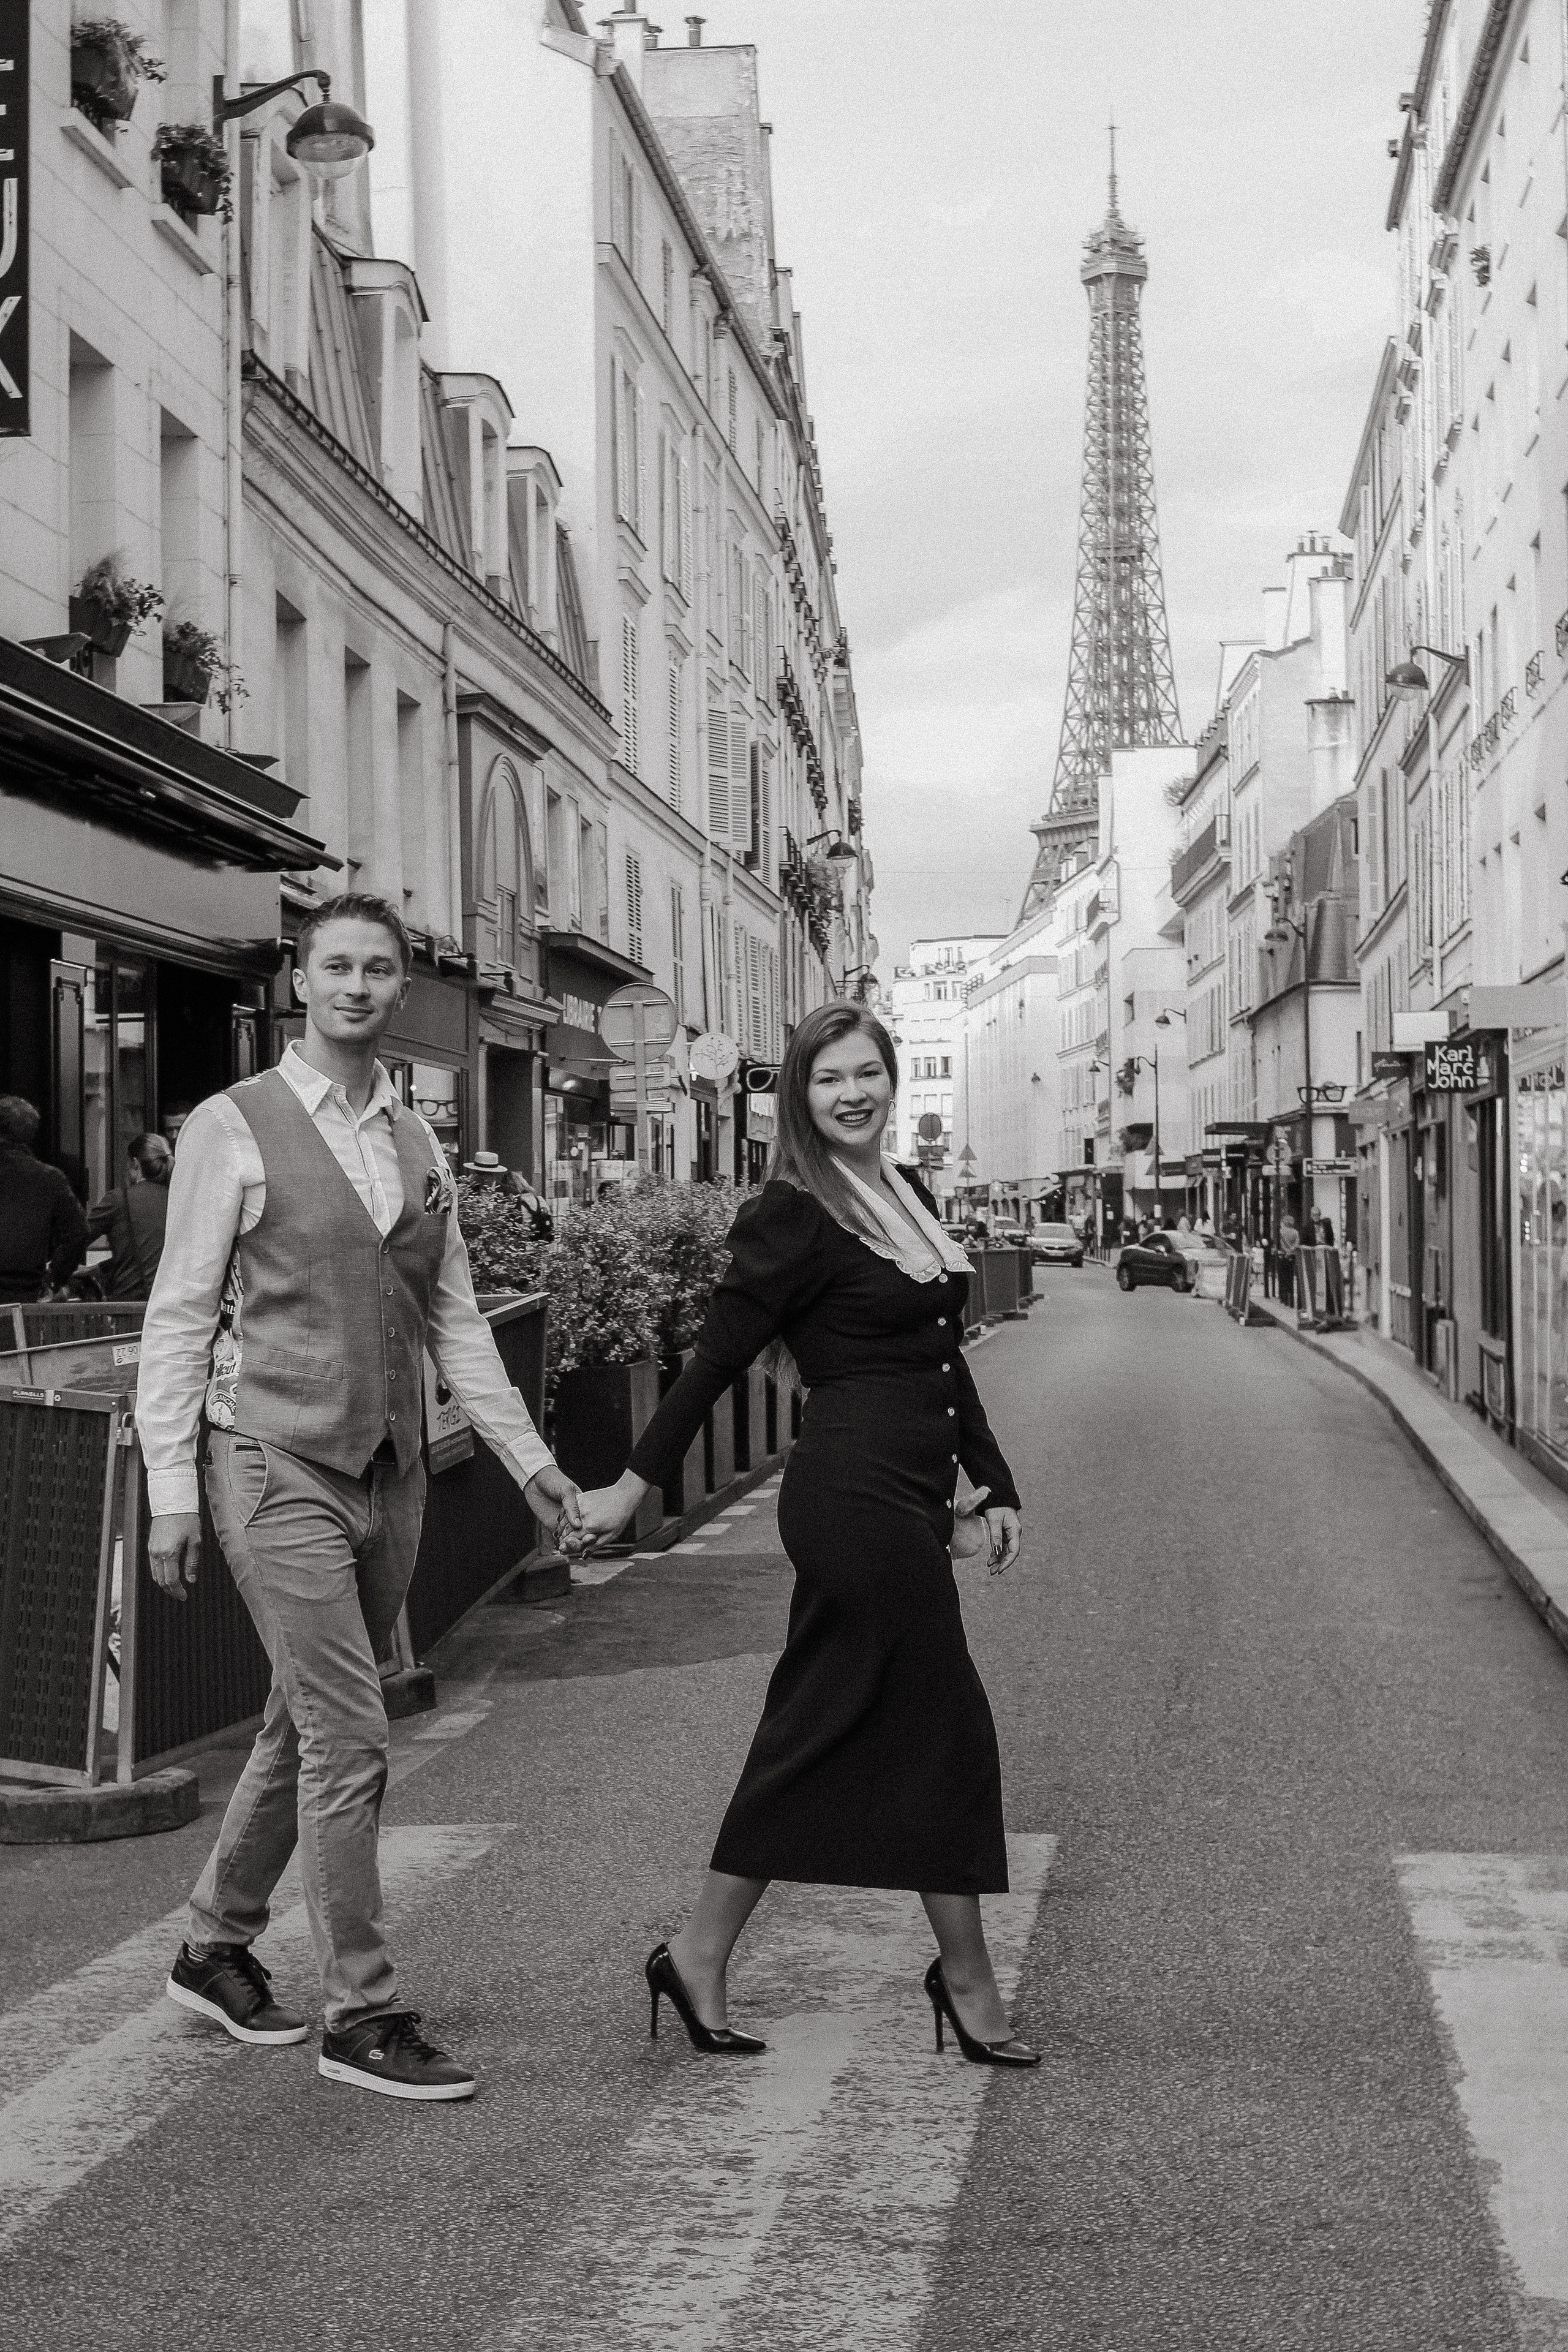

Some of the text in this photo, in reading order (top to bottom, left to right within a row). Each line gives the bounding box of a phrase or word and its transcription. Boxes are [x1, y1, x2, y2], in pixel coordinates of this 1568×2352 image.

[1434, 1045, 1474, 1062] Karl
[1427, 1058, 1474, 1075] Marc
[1428, 1073, 1474, 1088] John
